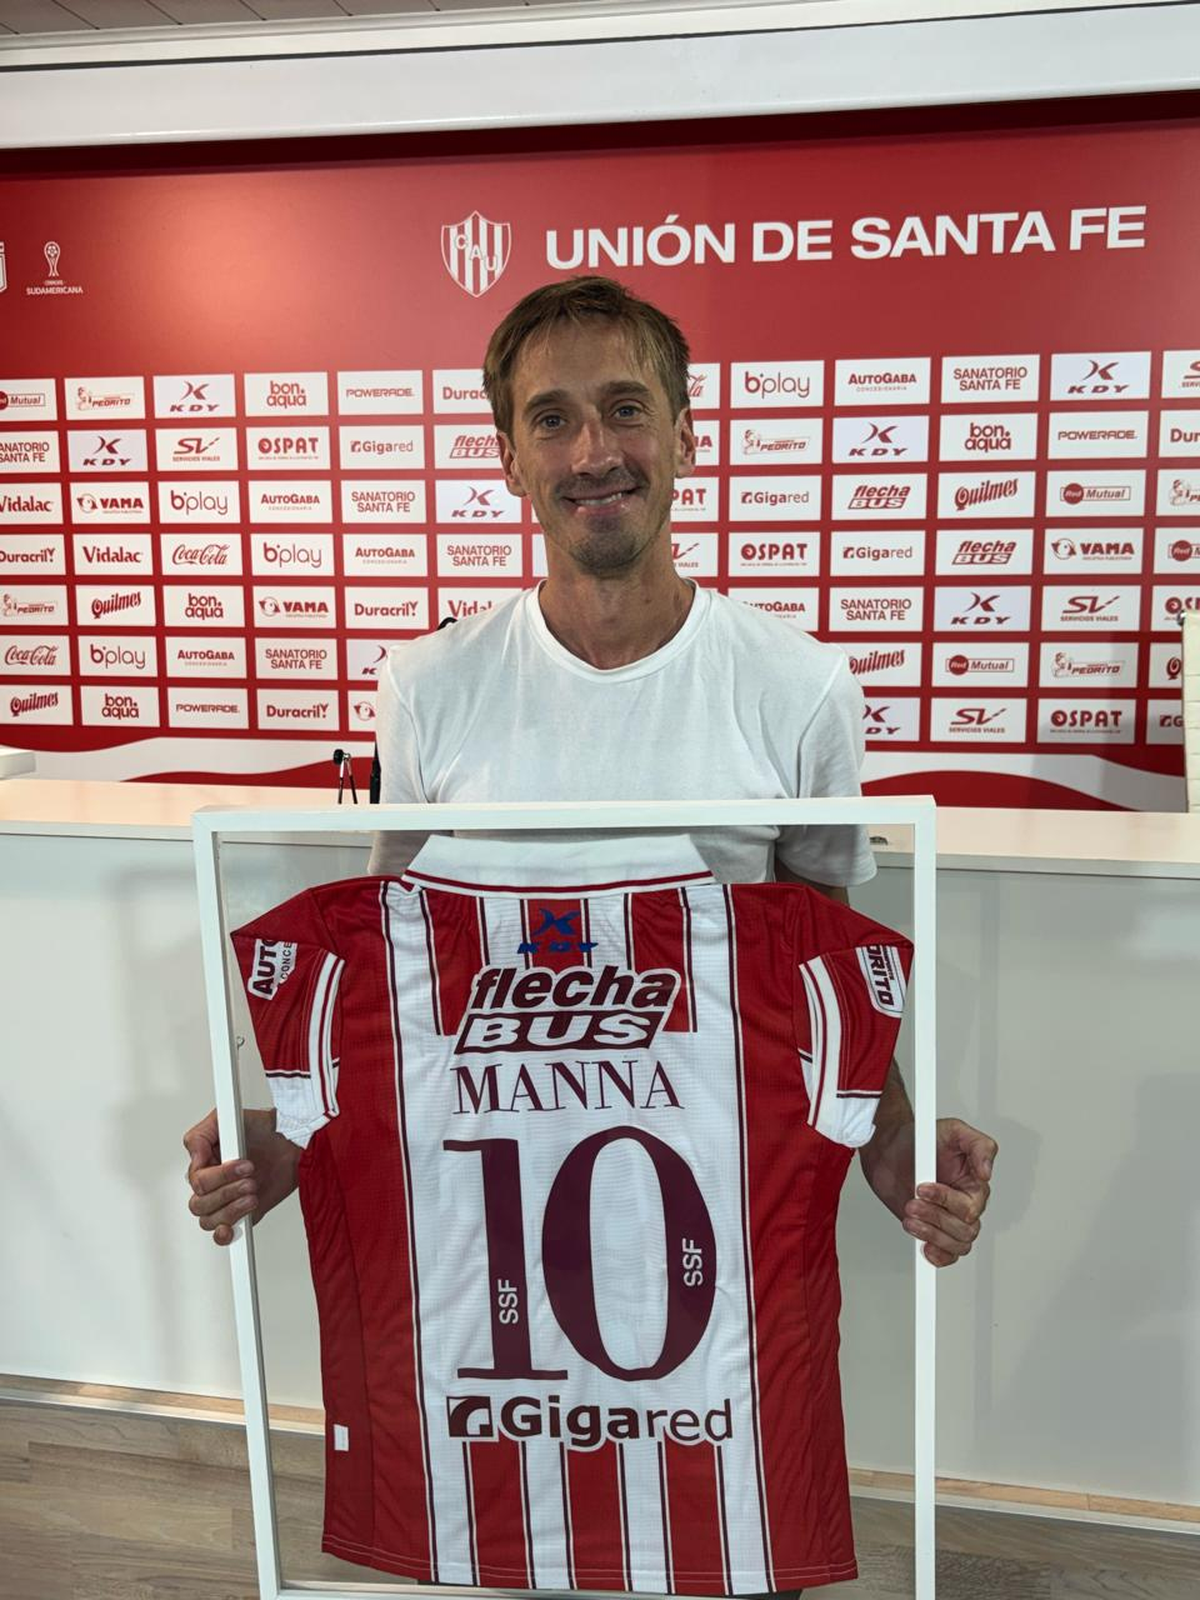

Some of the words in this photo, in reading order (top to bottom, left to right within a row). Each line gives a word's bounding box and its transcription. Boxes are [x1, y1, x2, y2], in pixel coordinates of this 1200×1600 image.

[546, 213, 736, 270] UNIÓN
[752, 219, 834, 263] DE
[850, 210, 1057, 260] SANTA
[1069, 205, 1147, 251] FE
[26, 286, 84, 295] SUDAMERICANA
[953, 366, 1028, 380] SANATORIO
[959, 380, 1001, 392] SANTA
[1005, 379, 1021, 390] FE
[1068, 385, 1128, 394] KDY
[346, 388, 413, 397] POWERADE
[265, 394, 308, 410] aqua
[1058, 430, 1136, 440] POWERADE
[258, 437, 318, 454] OSPAT
[362, 441, 413, 455] Gigared
[964, 437, 1011, 452] aqua
[33, 452, 45, 462] FE
[849, 448, 907, 456] KDY
[351, 491, 416, 501] SANATORIO
[668, 488, 706, 506] PAT
[853, 485, 911, 497] flecha
[955, 479, 1018, 511] Quilmes
[1086, 490, 1125, 498] Mutual
[100, 498, 143, 509] VAMA
[754, 492, 809, 506] Gigared
[850, 498, 904, 509] BUS
[357, 501, 393, 513] SANTA
[396, 501, 411, 512] FE
[452, 510, 503, 518] KDY
[447, 545, 512, 555] SANATORIO
[741, 543, 807, 560] OSPAT
[958, 541, 1017, 553] flecha
[1079, 542, 1135, 555] VAMA
[83, 546, 140, 563] Vidalac
[856, 547, 912, 561] Gigared
[953, 554, 1010, 564] BUS
[453, 555, 489, 567] SANTA
[493, 556, 507, 566] FE
[91, 592, 141, 619] Quilmes
[283, 602, 328, 612] VAMA
[840, 599, 912, 610] SANATORIO
[185, 606, 223, 620] aqua
[846, 611, 885, 620] SANTA
[890, 610, 905, 620] FE
[265, 649, 327, 659] SANATORIO
[271, 660, 306, 669] SANTA
[309, 660, 323, 669] FE
[971, 661, 1009, 669] Mutual
[10, 693, 58, 717] Quilmes
[176, 704, 238, 713] POWERADE
[101, 706, 140, 721] aqua
[1051, 710, 1124, 727] OSPAT
[865, 726, 901, 735] DY
[471, 966, 677, 1009] flecha
[463, 1014, 651, 1048] BUS
[450, 1060, 685, 1115] MANNA
[443, 1126, 717, 1382] 10
[682, 1238, 703, 1287] SSF
[497, 1279, 518, 1325] SSF
[500, 1395, 733, 1448] Gigared
